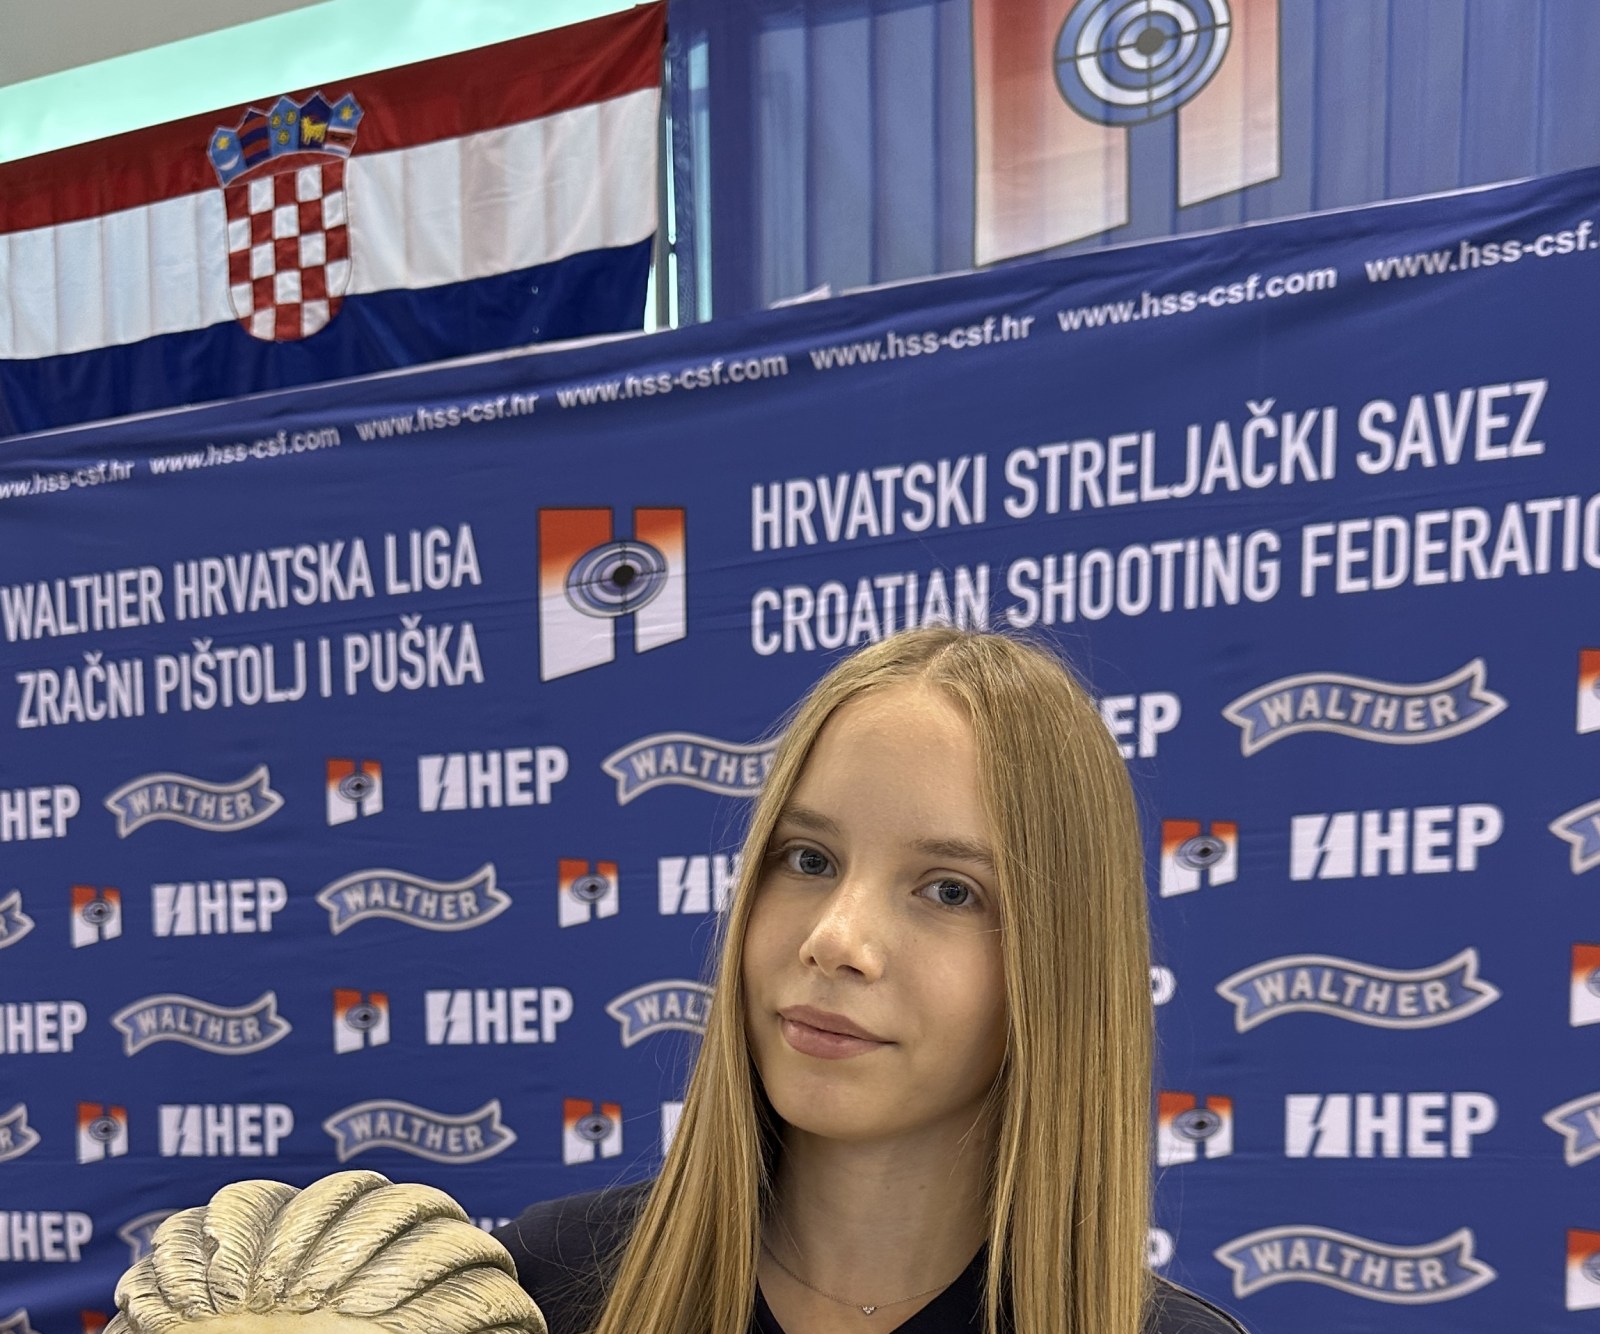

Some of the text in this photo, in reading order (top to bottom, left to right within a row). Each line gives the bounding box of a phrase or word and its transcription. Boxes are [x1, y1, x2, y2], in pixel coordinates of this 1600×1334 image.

[149, 428, 340, 474] www.hss-csf.com
[356, 393, 540, 441] www.hss-csf.hr
[556, 354, 788, 408] www.hss-csf.com
[810, 314, 1035, 371] www.hss-csf.hr
[1057, 263, 1338, 333] www.hss-csf.com
[751, 378, 1549, 552] HRVATSKI STRELJAČKI SAVEZ
[0, 523, 482, 642] WALTHER HRVATSKA LIGA
[751, 563, 990, 656] CROATIAN
[1005, 528, 1281, 629] SHOOTING
[15, 614, 484, 729] ZRAČNI PIŠTOLJ I PUŠKA
[1100, 691, 1182, 760] EP
[1260, 687, 1460, 732] WALTHER
[128, 784, 255, 821] WALTHER
[468, 746, 569, 809] HEP
[0, 784, 81, 842] HEP
[1360, 803, 1504, 876] HEP
[198, 878, 288, 935] HEP
[342, 880, 480, 921] WALTHER
[474, 986, 573, 1044] HEP
[1253, 968, 1452, 1017] WALTHER
[5, 1000, 88, 1054] HEP
[136, 1004, 262, 1045] WALTHER
[204, 1104, 294, 1156] HEP
[351, 1111, 485, 1153] WALTHER
[1355, 1091, 1499, 1159] HEP
[10, 1210, 93, 1263] HEP
[1251, 1239, 1448, 1292] WALTHER
